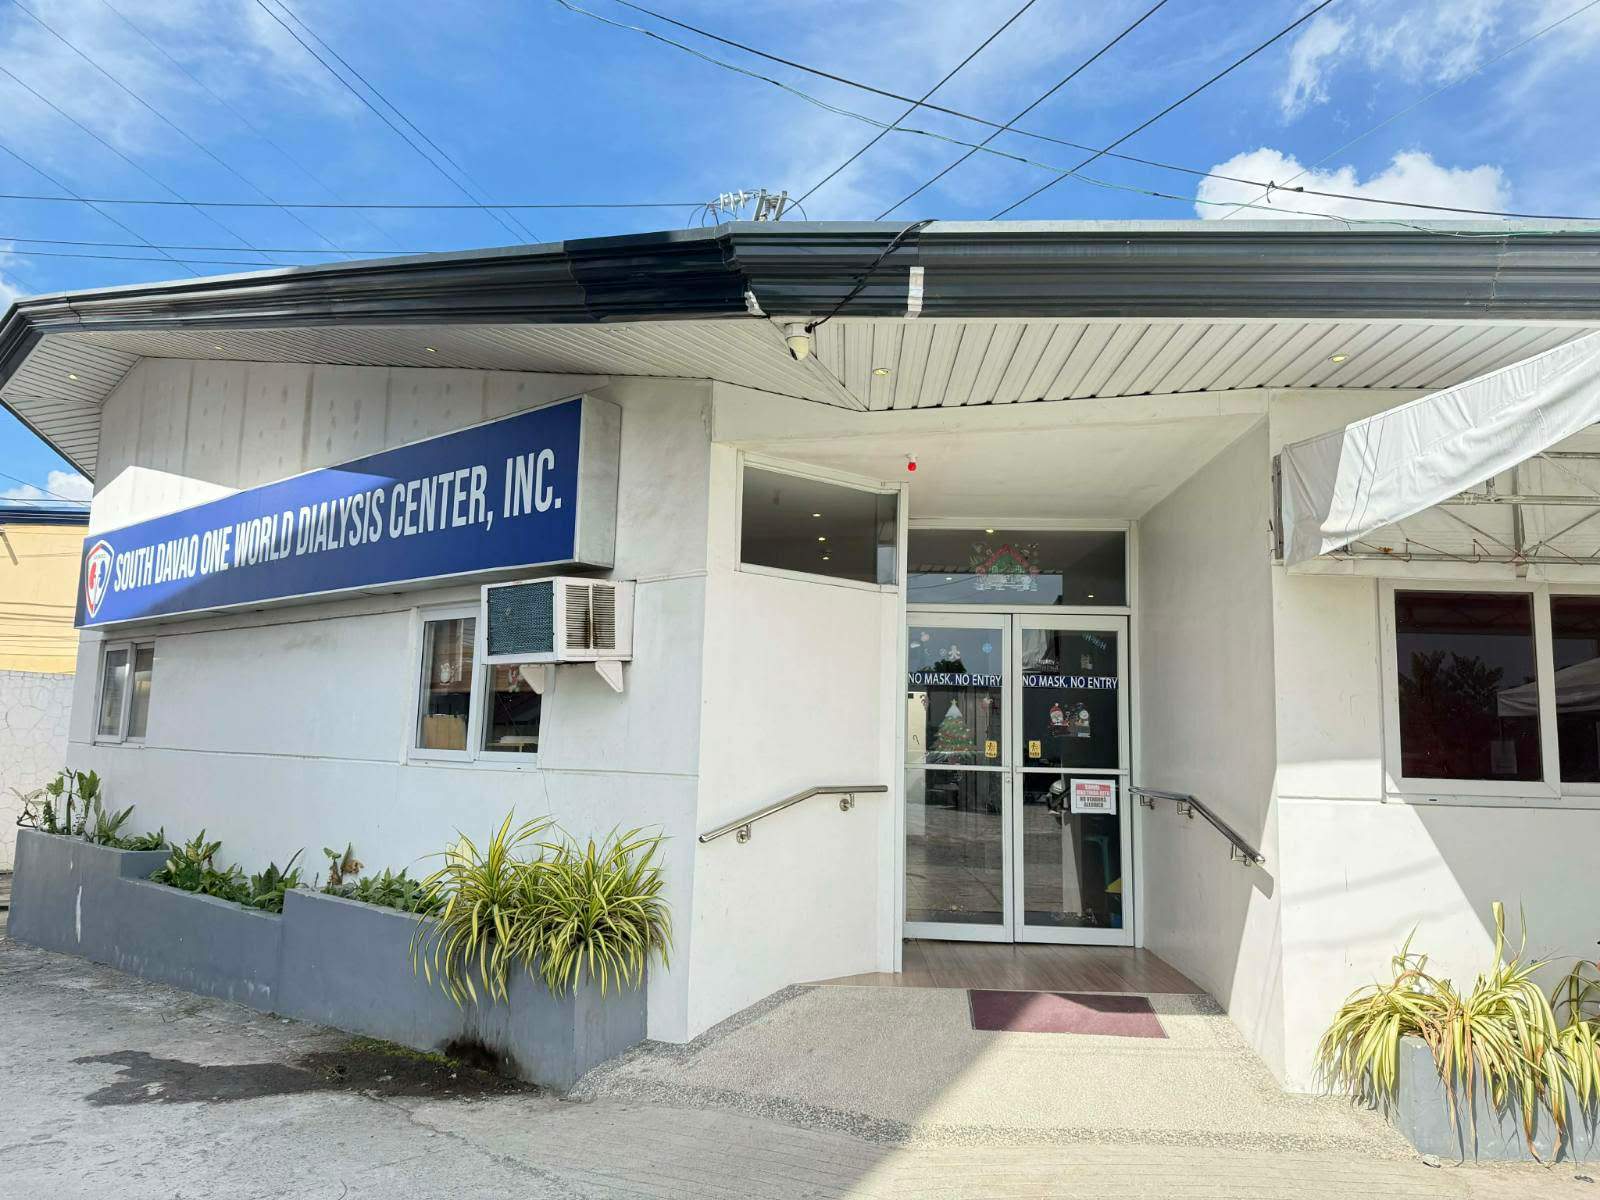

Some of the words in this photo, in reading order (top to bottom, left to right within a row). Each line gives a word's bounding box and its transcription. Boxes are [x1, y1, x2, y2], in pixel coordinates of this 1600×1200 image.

[114, 545, 154, 592] SOUTH
[155, 534, 199, 583] DAVAO
[200, 526, 232, 575] ONE
[234, 511, 294, 568] WORLD
[296, 488, 384, 556] DIALYSIS
[389, 464, 494, 539] CENTER,
[503, 448, 562, 519] INC.
[908, 672, 922, 684] NO
[955, 674, 970, 685] NO
[972, 674, 1001, 686] ENTRY
[1022, 675, 1036, 687] NO
[1070, 676, 1085, 688] NO
[1087, 677, 1117, 689] ENTRY
